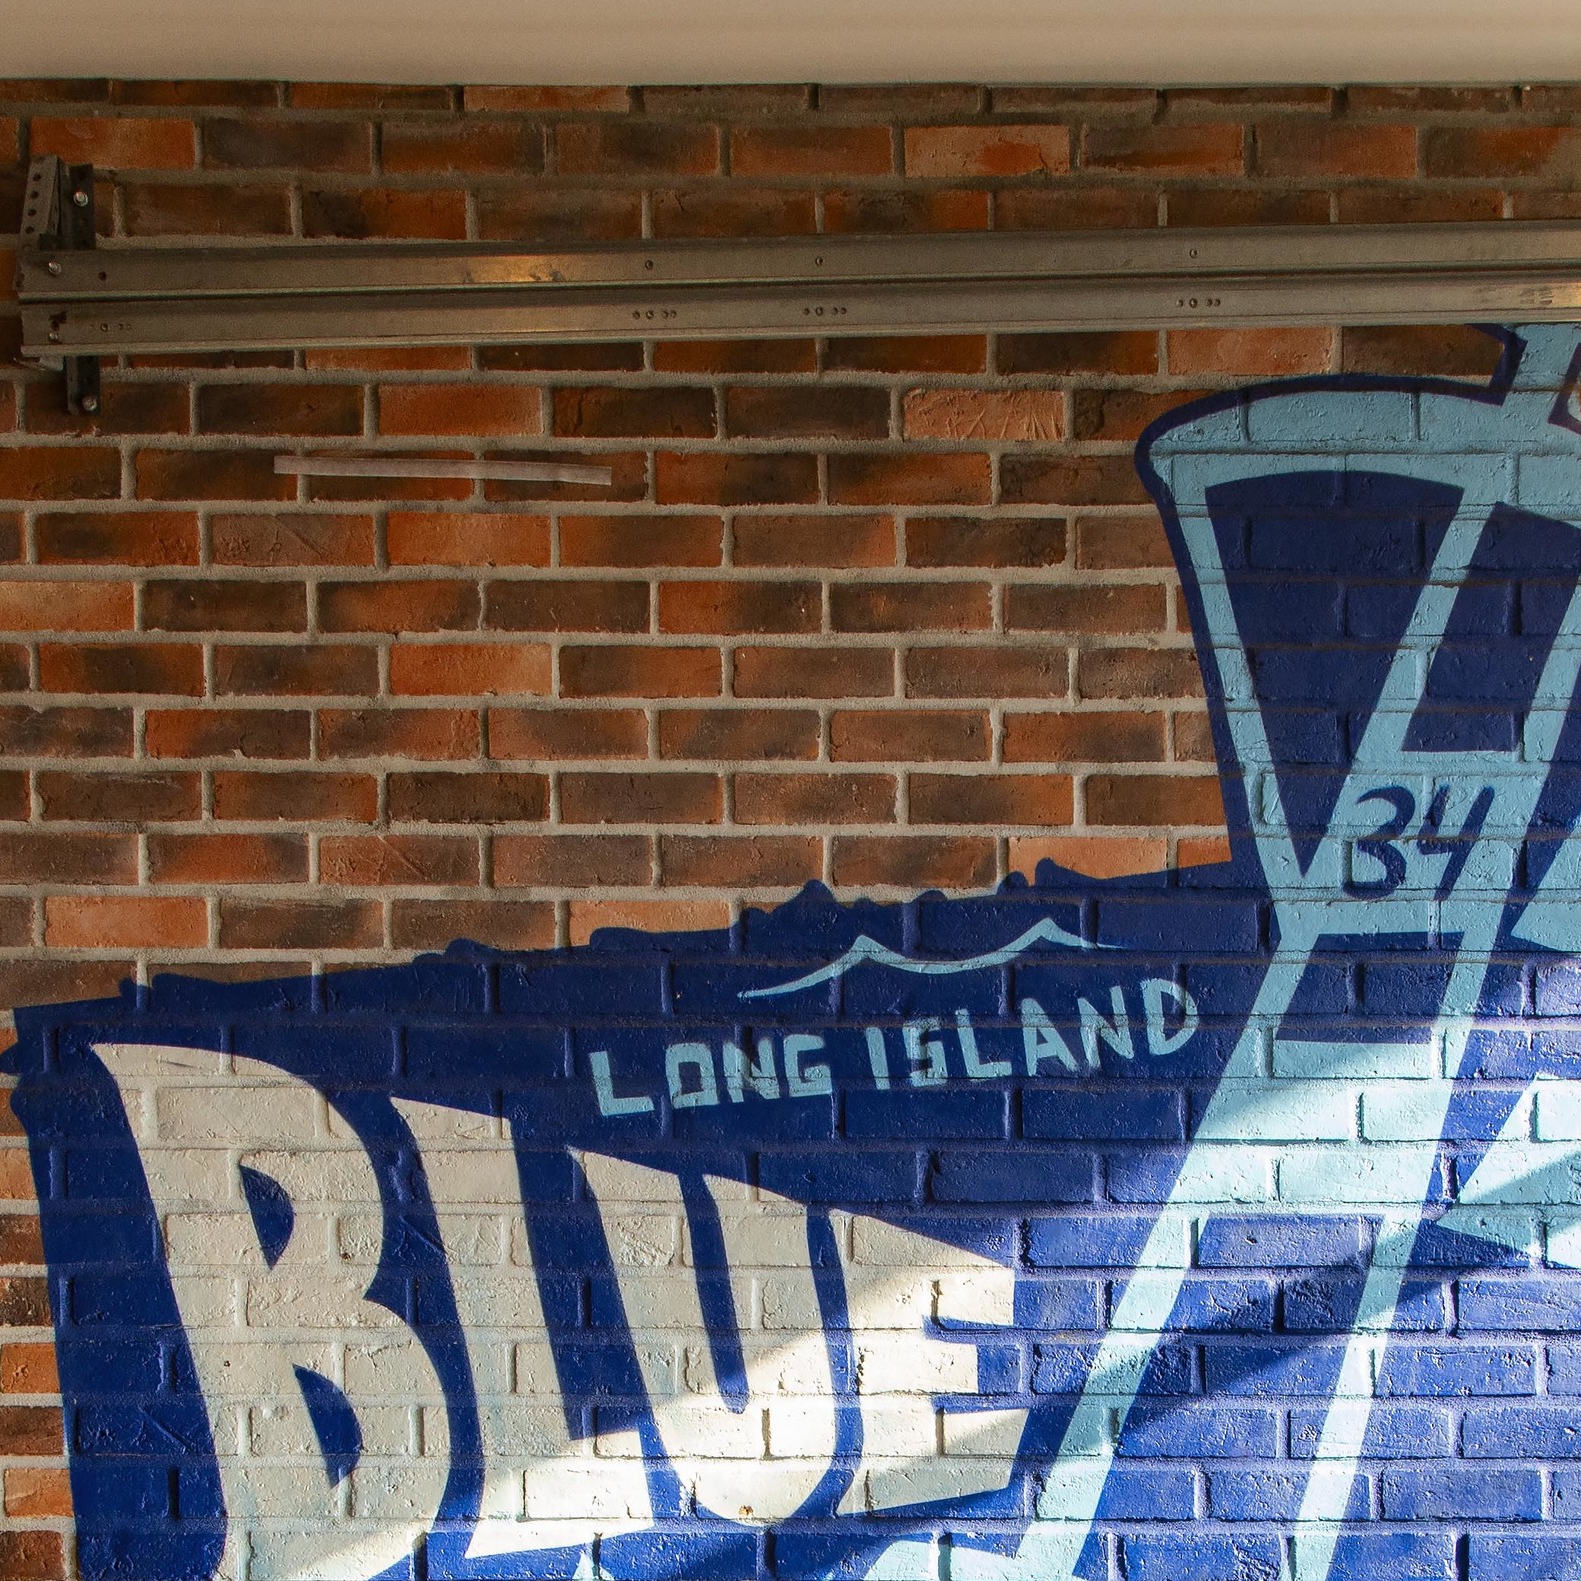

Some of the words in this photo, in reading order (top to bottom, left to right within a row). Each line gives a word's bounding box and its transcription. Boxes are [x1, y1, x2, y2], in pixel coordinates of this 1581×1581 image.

[1342, 784, 1496, 901] 34
[589, 1033, 834, 1117] LONG
[866, 977, 1200, 1090] ISLAND
